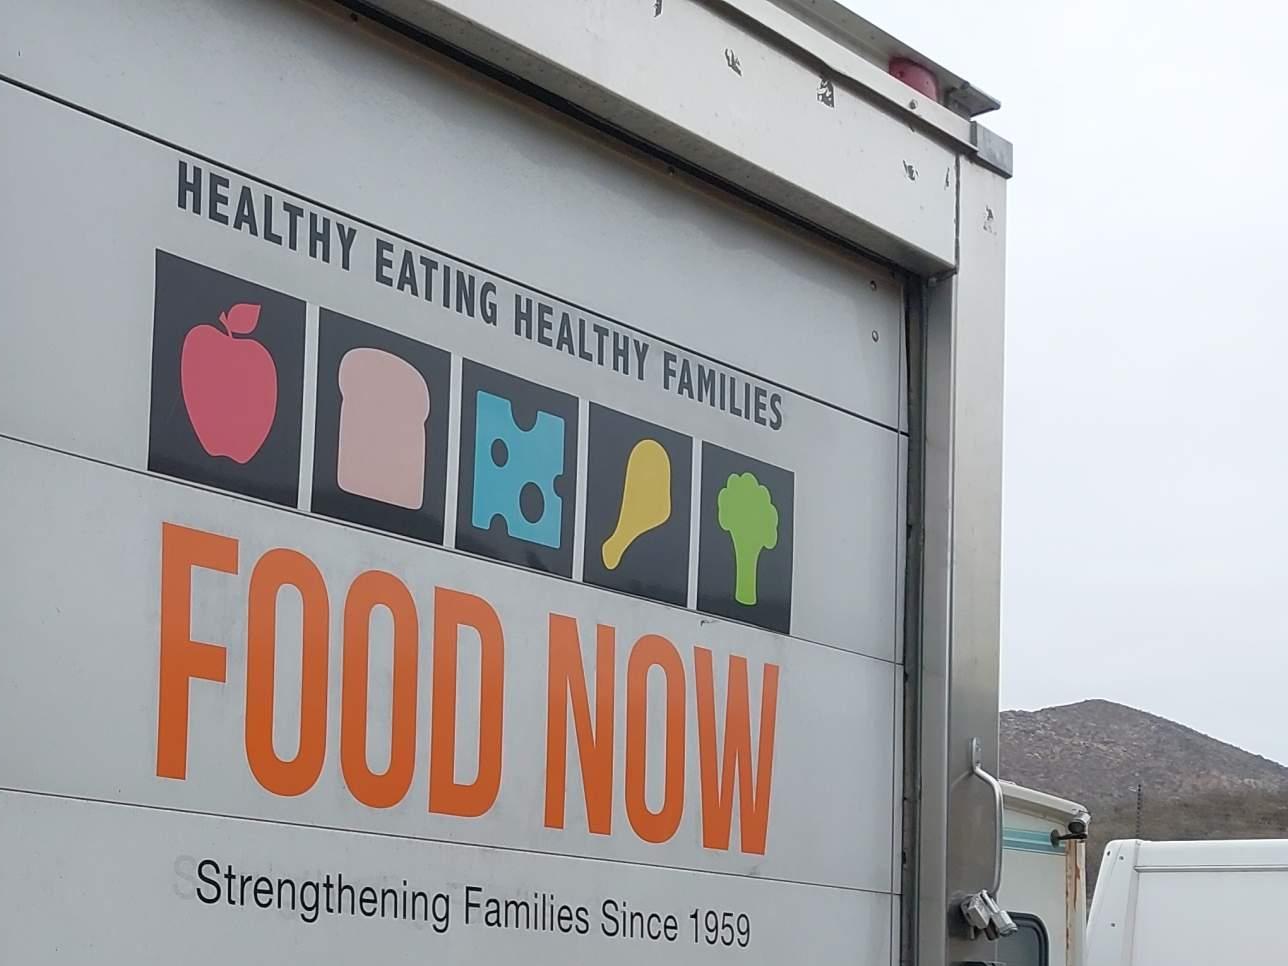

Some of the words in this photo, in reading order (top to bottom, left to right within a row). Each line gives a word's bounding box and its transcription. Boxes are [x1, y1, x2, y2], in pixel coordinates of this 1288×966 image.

[177, 160, 356, 271] HEALTHY
[374, 237, 498, 326] EATING
[513, 293, 649, 382] HEALTHY
[663, 350, 783, 431] FAMILIES
[156, 522, 505, 818] FOOD
[544, 612, 780, 855] NOW
[196, 859, 451, 933] Strengthening
[463, 885, 590, 935] Families
[600, 901, 679, 942] Since
[689, 910, 751, 947] 1959
